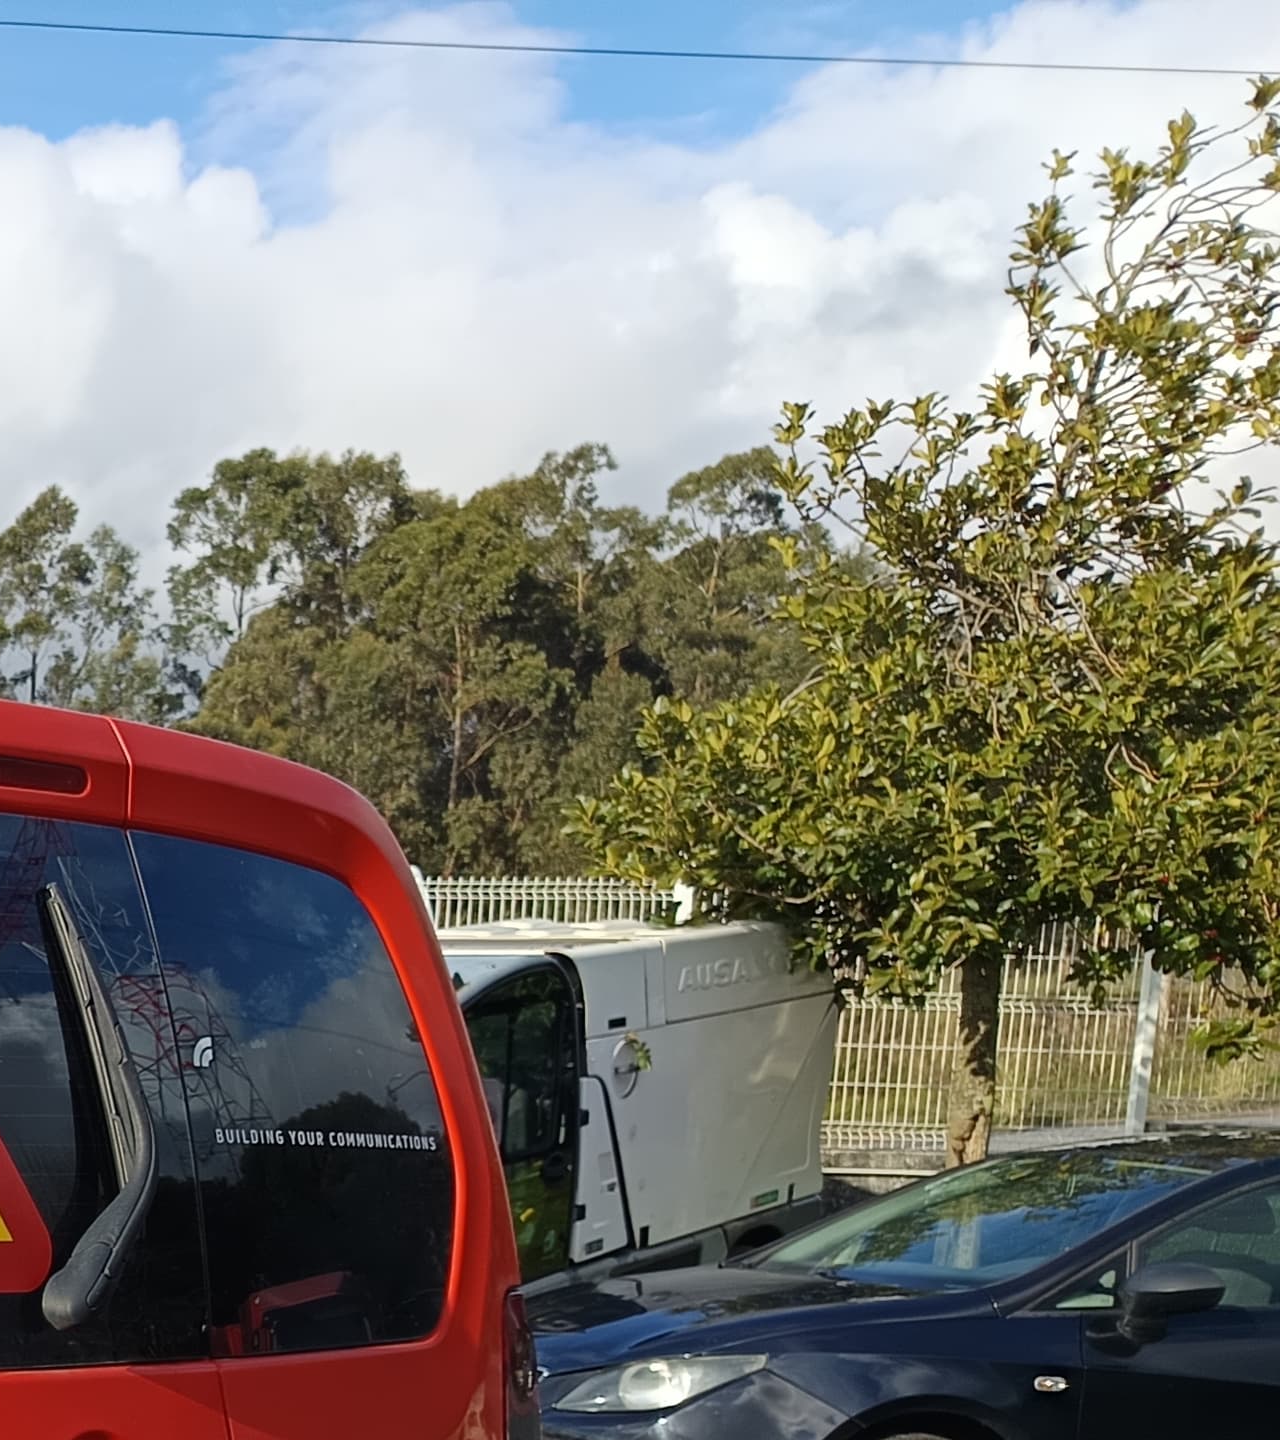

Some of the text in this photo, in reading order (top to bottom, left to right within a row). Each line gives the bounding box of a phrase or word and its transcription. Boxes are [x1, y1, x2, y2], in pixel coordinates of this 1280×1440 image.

[677, 957, 751, 993] AUSA
[215, 1128, 438, 1151] BUILDING YOUR COMMUNICATIONS
